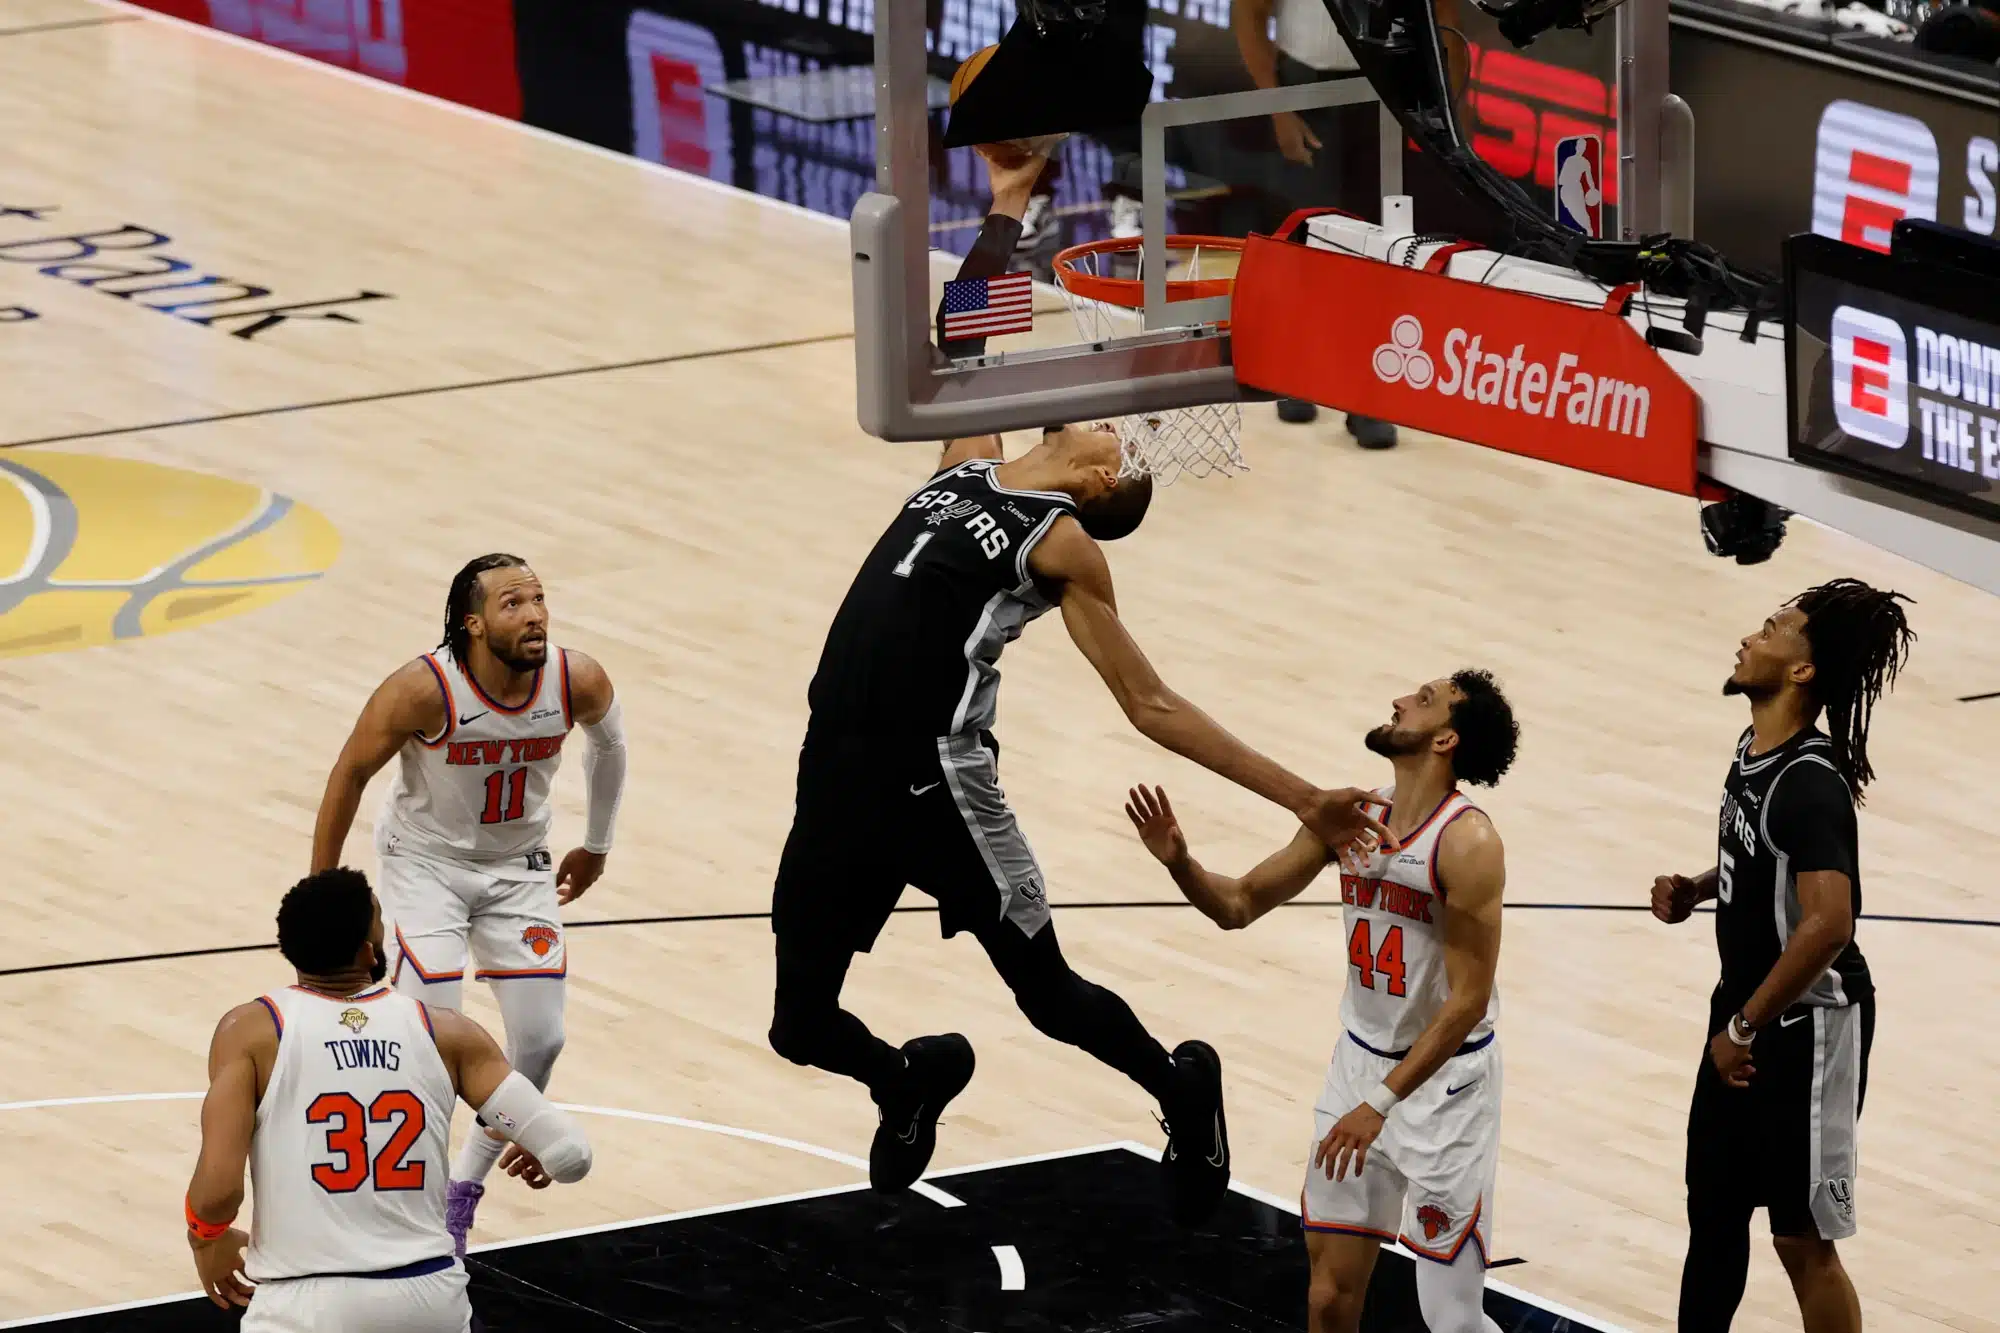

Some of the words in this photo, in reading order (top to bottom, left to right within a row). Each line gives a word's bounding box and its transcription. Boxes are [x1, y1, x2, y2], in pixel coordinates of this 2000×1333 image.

[1963, 135, 2000, 236] S
[0, 223, 397, 340] Bank
[1918, 397, 1975, 473] THE
[1979, 415, 2000, 480] E
[892, 531, 936, 578] 1
[908, 489, 1011, 560] SPURS
[446, 740, 507, 766] NEW
[480, 766, 528, 825] 11
[1379, 879, 1434, 925] YORK
[1718, 845, 1735, 906] 5
[1348, 917, 1407, 998] 44
[324, 1038, 401, 1071] TOWNS
[306, 1089, 427, 1194] 32
